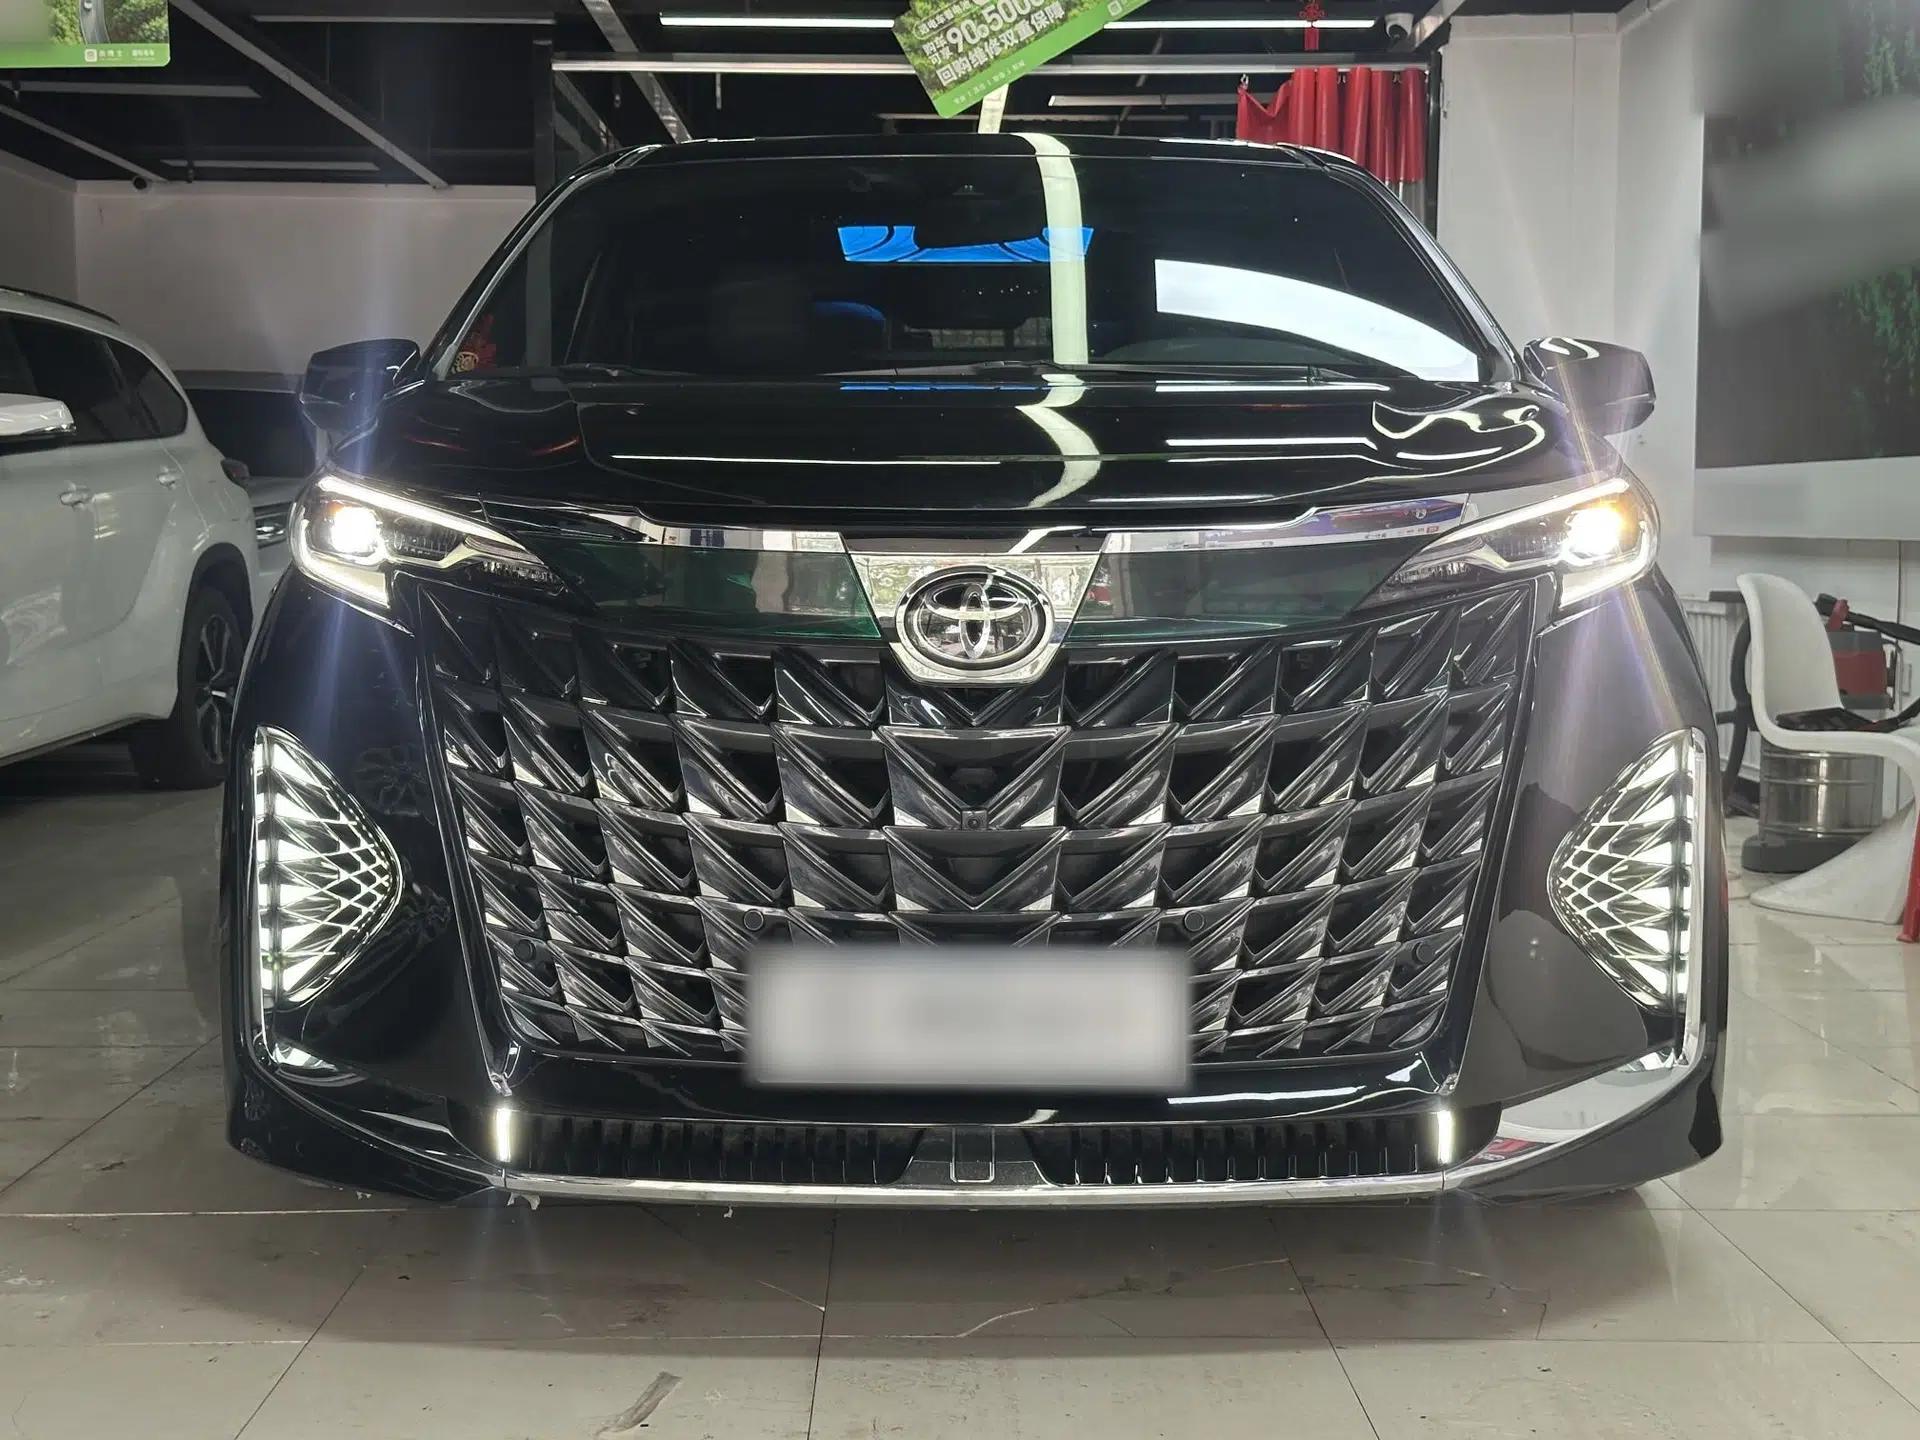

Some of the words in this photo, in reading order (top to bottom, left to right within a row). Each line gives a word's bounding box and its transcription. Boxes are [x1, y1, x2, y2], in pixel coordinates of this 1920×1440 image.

[936, 2, 1065, 86] 回购维修双重保障
